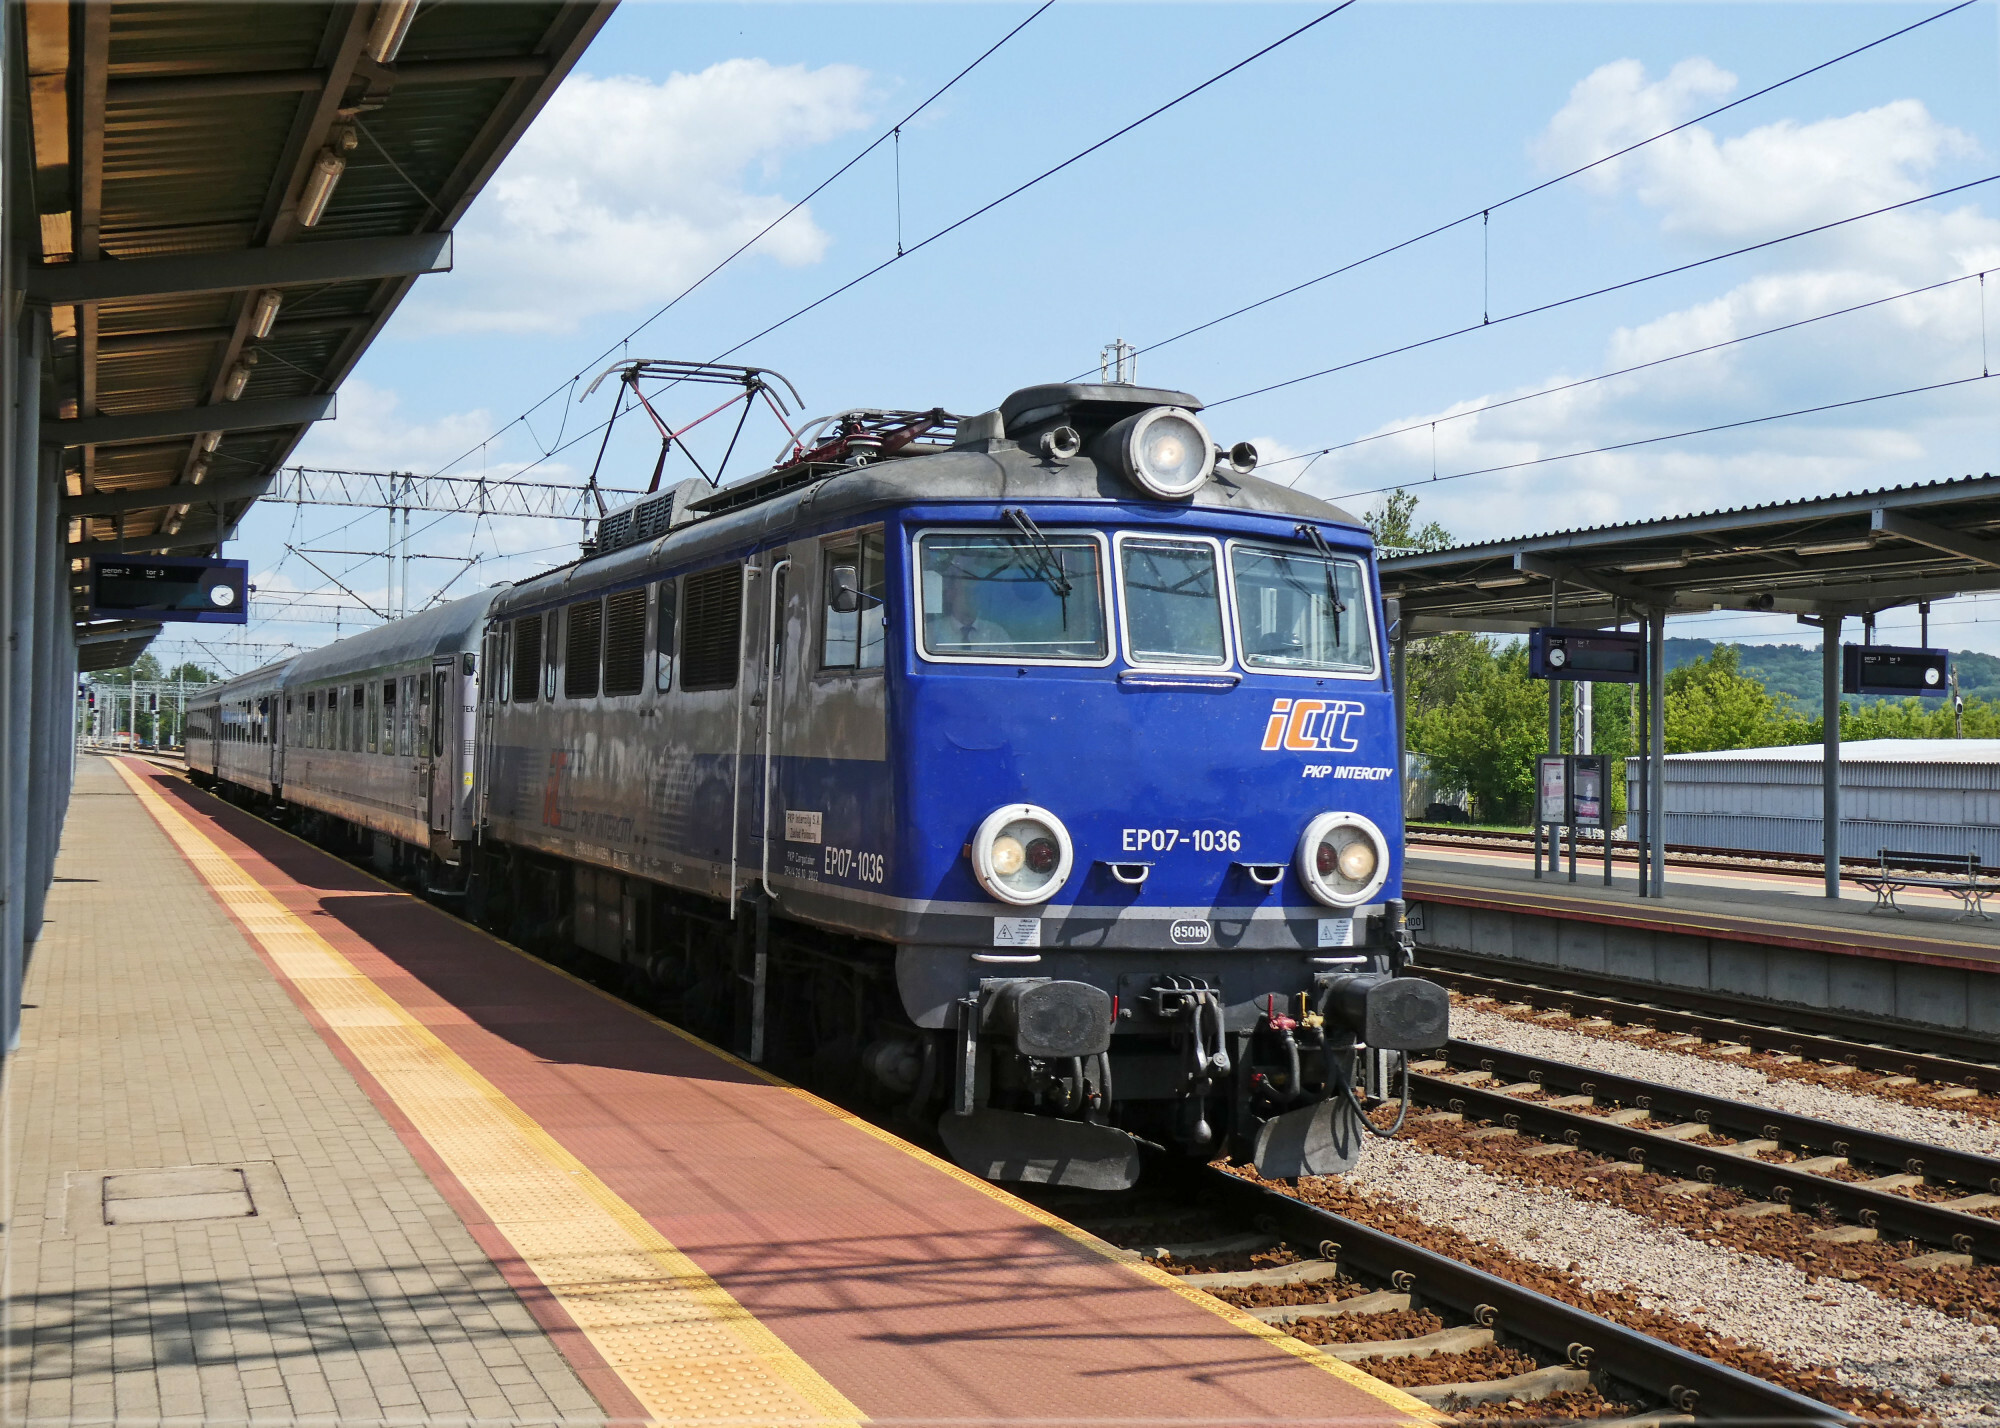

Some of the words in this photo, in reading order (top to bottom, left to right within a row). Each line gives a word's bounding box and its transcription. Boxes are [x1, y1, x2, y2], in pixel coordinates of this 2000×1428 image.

[1302, 764, 1333, 779] PKP
[1333, 765, 1394, 781] INTERCITY
[1122, 828, 1241, 852] EP07-1036
[824, 846, 884, 884] EP07-1036
[1407, 917, 1421, 927] 100
[1173, 925, 1209, 939] 850kN
